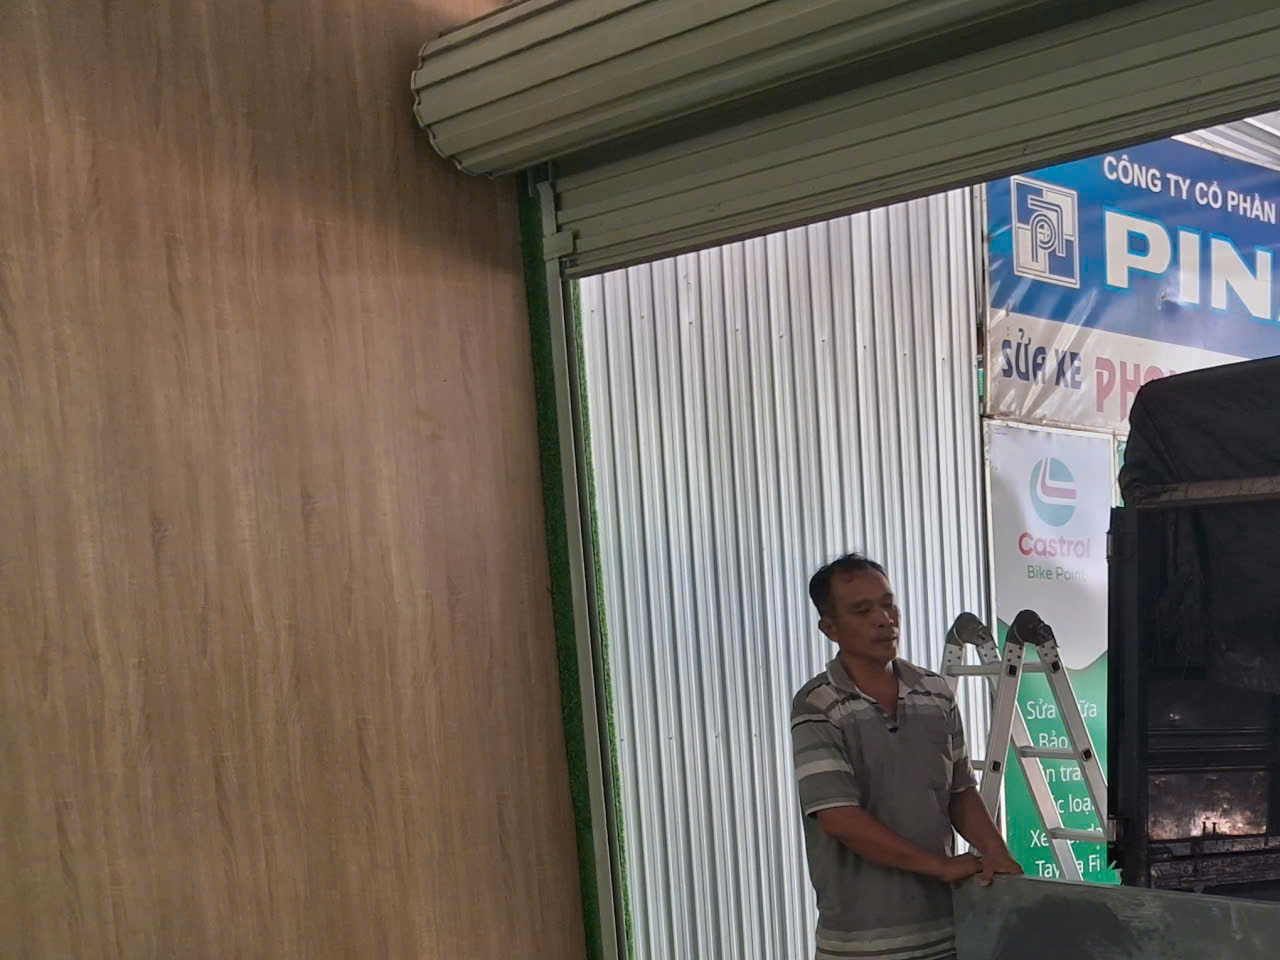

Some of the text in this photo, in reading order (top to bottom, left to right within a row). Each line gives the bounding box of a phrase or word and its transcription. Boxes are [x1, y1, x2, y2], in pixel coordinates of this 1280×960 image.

[1103, 154, 1162, 193] CÔNG
[1167, 173, 1191, 200] TY
[1228, 190, 1276, 225] PHẦN
[1055, 349, 1083, 390] XE
[1018, 532, 1090, 558] Castrol
[1027, 565, 1053, 580] Bike
[1026, 698, 1056, 719] Sửa
[1039, 730, 1068, 748] Bảo
[1069, 794, 1095, 815] loạ
